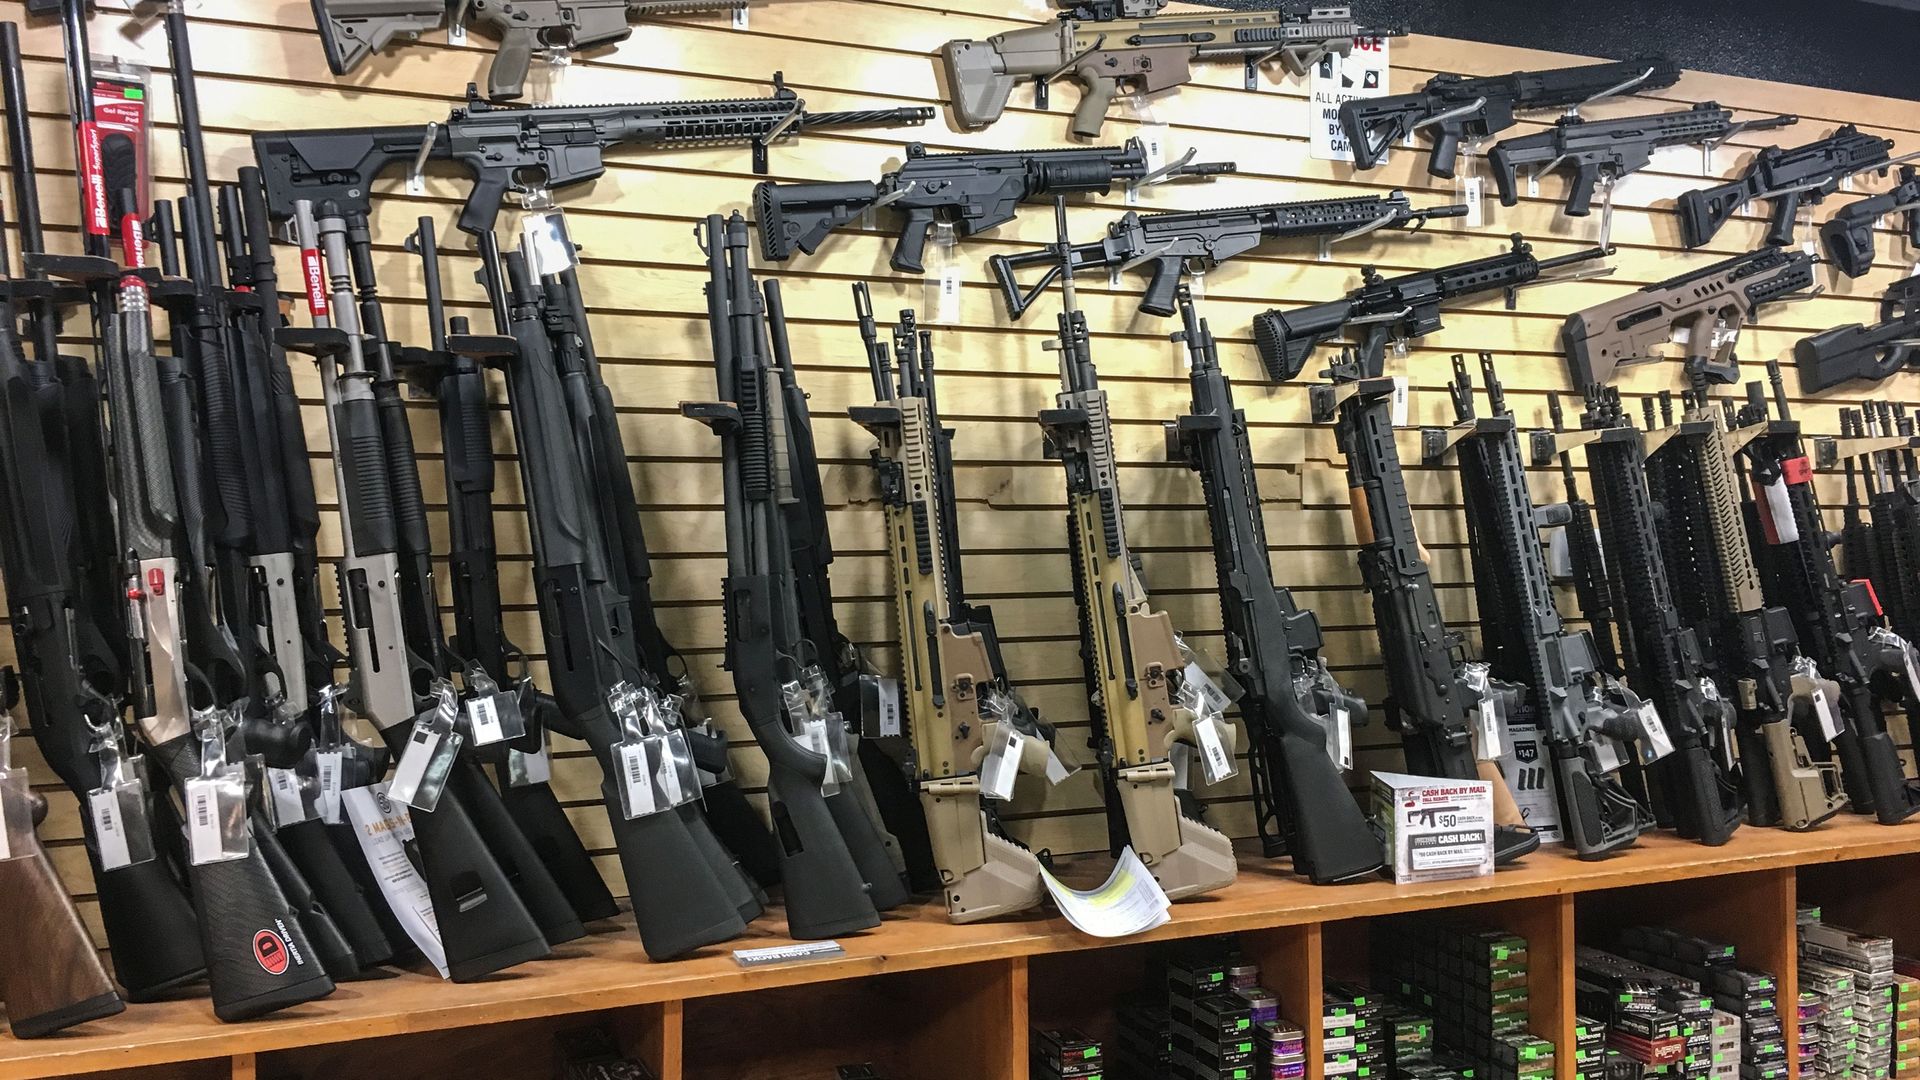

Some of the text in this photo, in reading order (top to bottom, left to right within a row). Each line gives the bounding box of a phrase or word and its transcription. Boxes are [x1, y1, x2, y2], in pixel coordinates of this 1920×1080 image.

[1315, 92, 1332, 104] ALL
[1329, 124, 1341, 135] BY
[91, 174, 107, 217] Benelli
[308, 266, 326, 308] Benelli
[1518, 749, 1534, 758] $147
[1422, 789, 1439, 797] CASH
[1440, 788, 1458, 796] BACK
[1469, 786, 1486, 794] MAIL
[1439, 814, 1457, 828] $50
[1438, 834, 1459, 844] CASH
[287, 942, 304, 965] INERTIA
